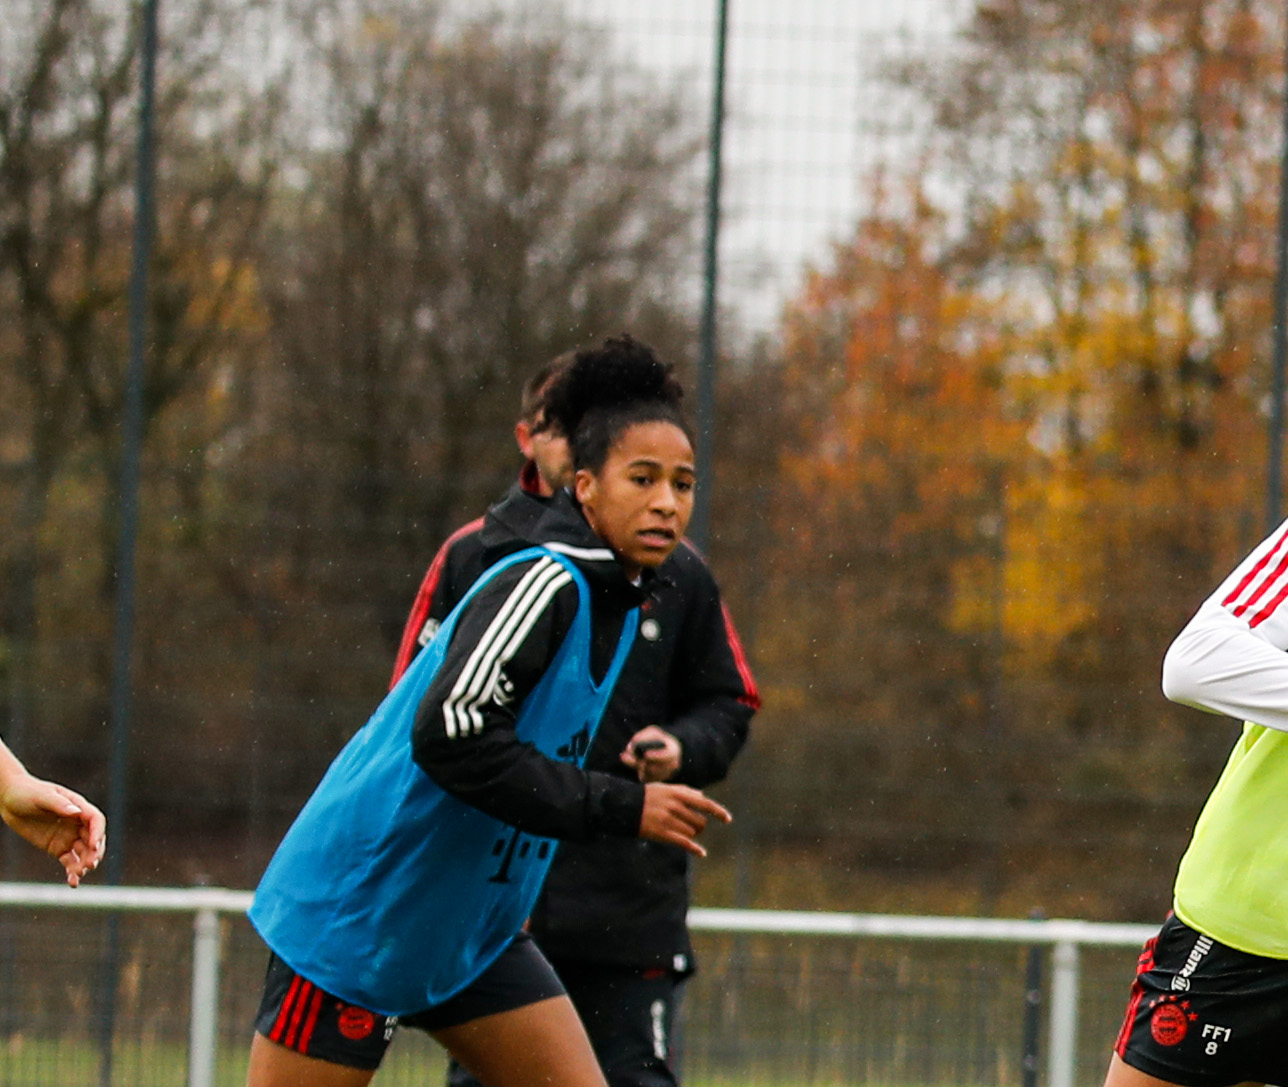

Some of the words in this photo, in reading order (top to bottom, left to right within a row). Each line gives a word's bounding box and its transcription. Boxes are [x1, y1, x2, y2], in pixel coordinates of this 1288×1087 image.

[1179, 934, 1213, 978] llianz
[1202, 1023, 1231, 1042] FF1
[1205, 1041, 1218, 1055] 8
